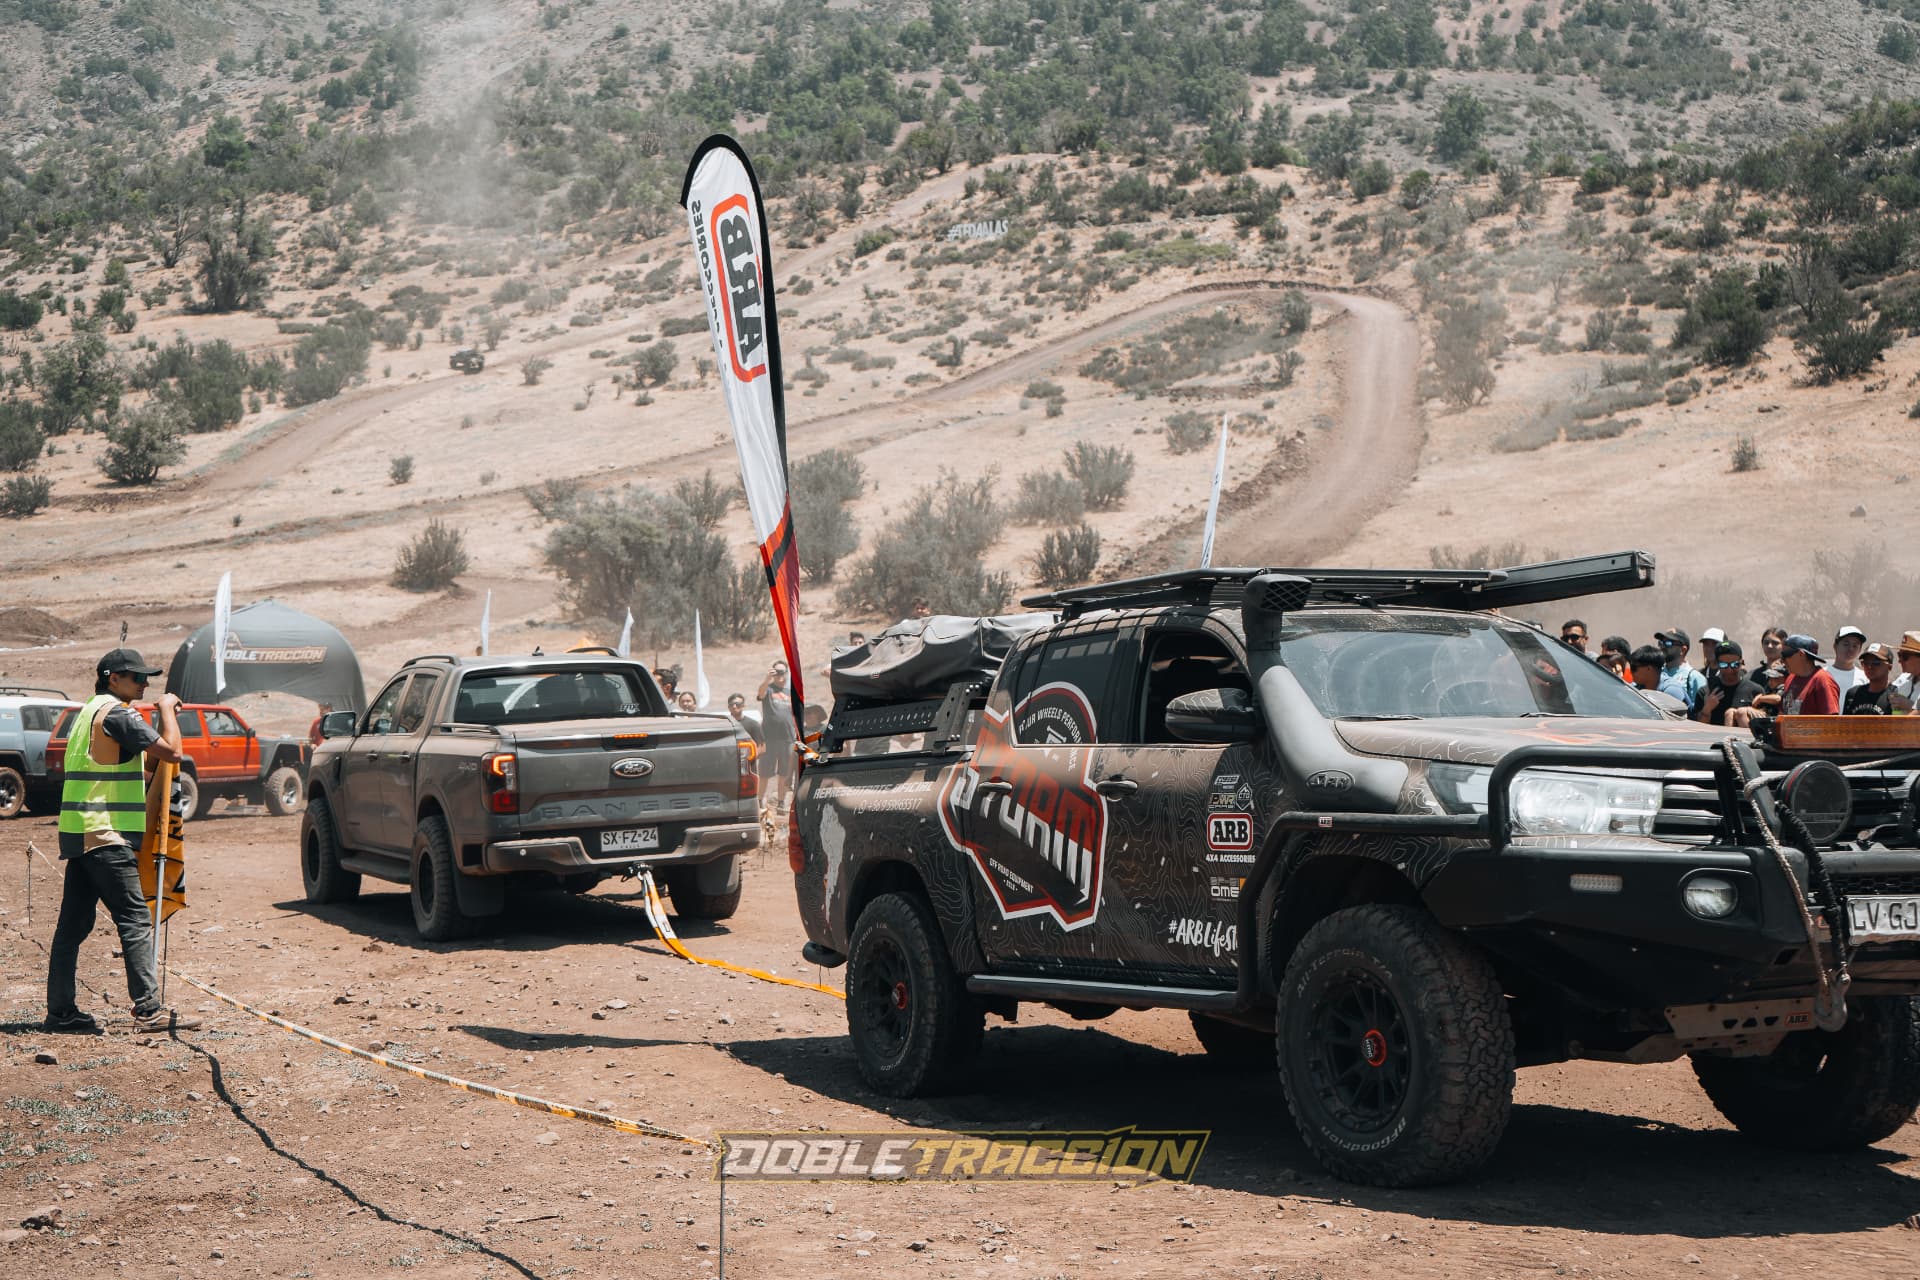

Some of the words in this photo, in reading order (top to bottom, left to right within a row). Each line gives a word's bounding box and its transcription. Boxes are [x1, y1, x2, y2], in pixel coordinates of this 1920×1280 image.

[1037, 707, 1063, 720] WHEELS
[541, 796, 721, 819] RANGER
[1212, 820, 1249, 843] ARB
[1220, 854, 1256, 863] ACCESSORIES
[1009, 871, 1034, 894] EQUIPMENT
[1211, 886, 1240, 898] OME
